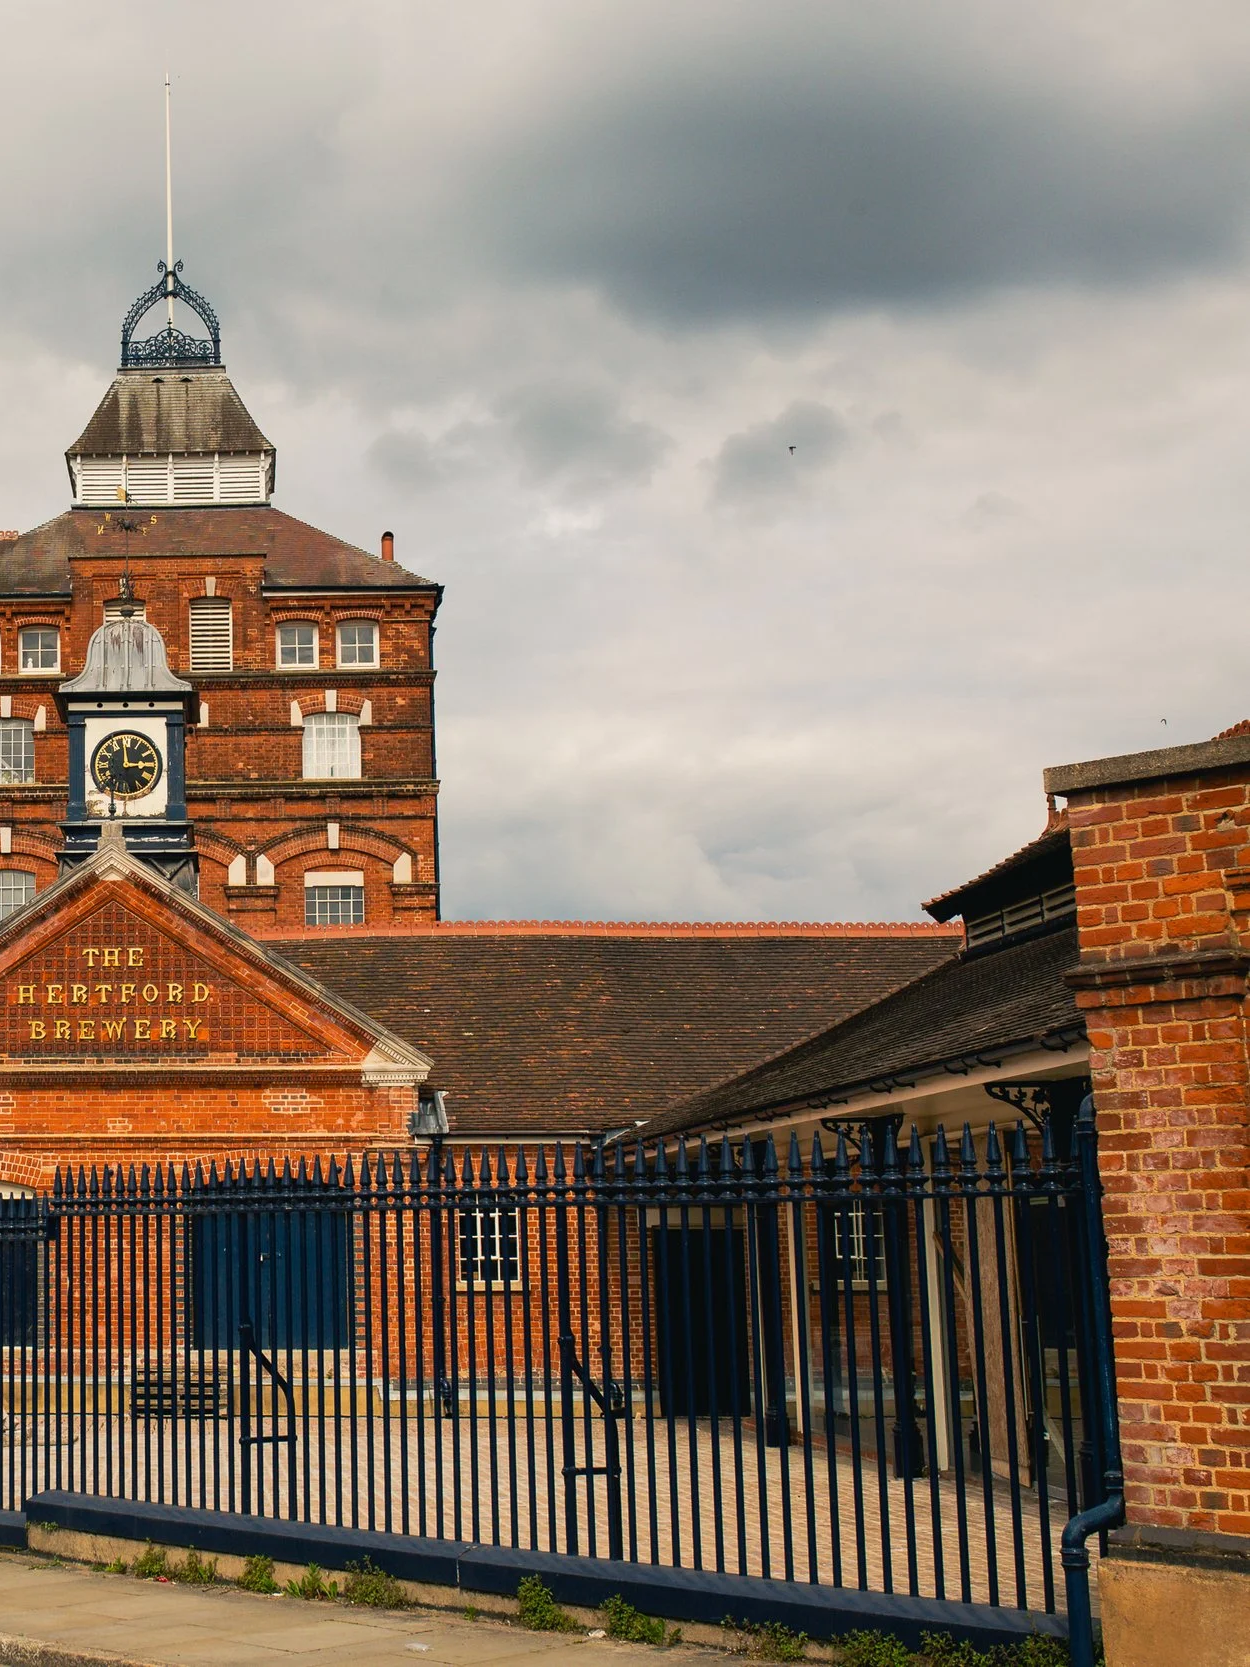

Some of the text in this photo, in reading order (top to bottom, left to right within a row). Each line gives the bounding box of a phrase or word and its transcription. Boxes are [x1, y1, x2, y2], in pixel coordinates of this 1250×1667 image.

[150, 515, 157, 524] S
[82, 947, 144, 967] THE
[17, 983, 210, 1004] HERTFORD
[28, 1017, 202, 1039] BREWERY
